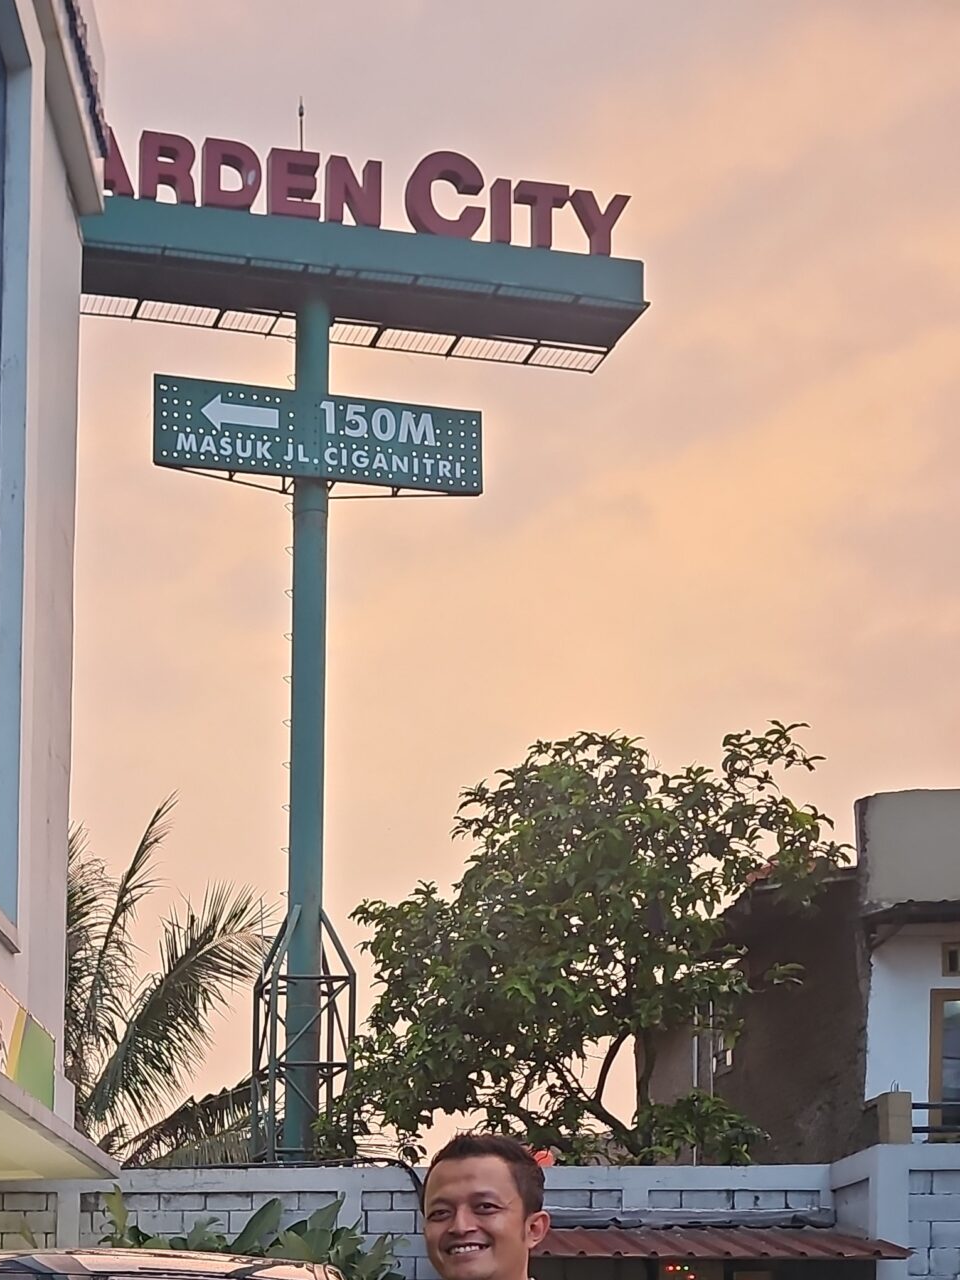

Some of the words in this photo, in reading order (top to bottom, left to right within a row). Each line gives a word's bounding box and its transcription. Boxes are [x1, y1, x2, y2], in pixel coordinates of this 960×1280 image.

[405, 150, 631, 257] CITY
[319, 400, 437, 447] 150M
[175, 432, 273, 461] MASUK
[323, 447, 462, 479] CIGANITRI
